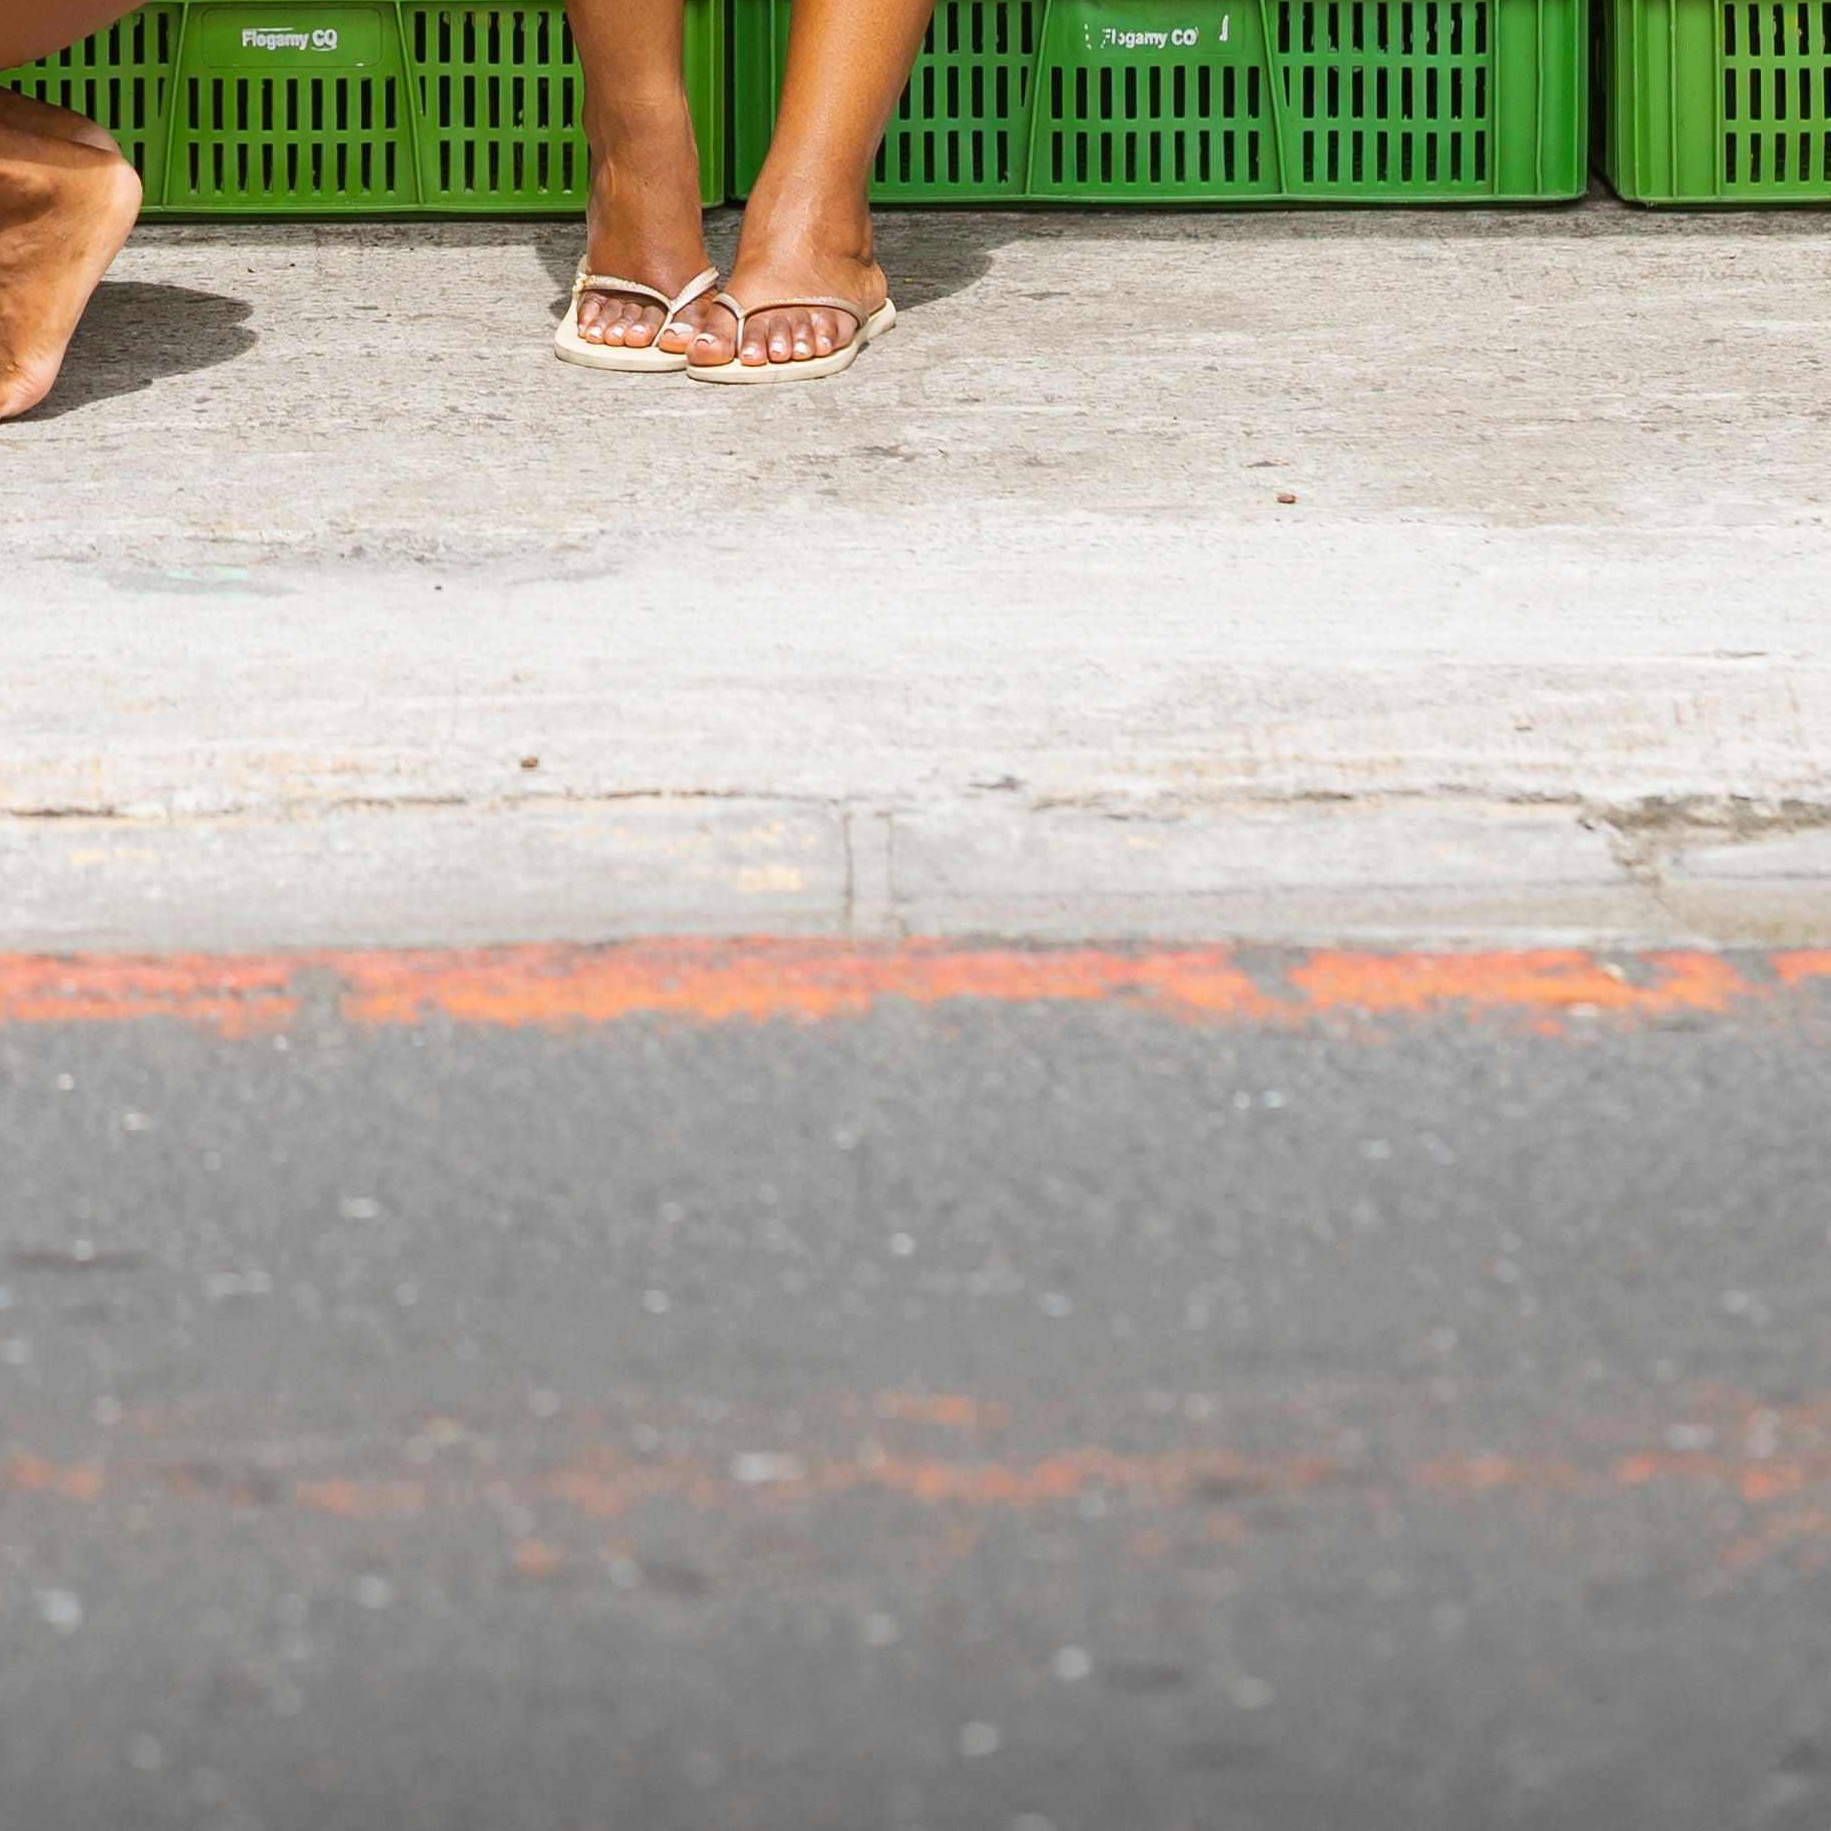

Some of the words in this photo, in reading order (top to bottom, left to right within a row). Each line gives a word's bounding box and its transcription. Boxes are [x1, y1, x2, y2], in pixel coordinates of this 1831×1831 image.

[241, 28, 310, 51] Flogamy
[312, 28, 338, 47] CO
[1171, 27, 1198, 46] CO
